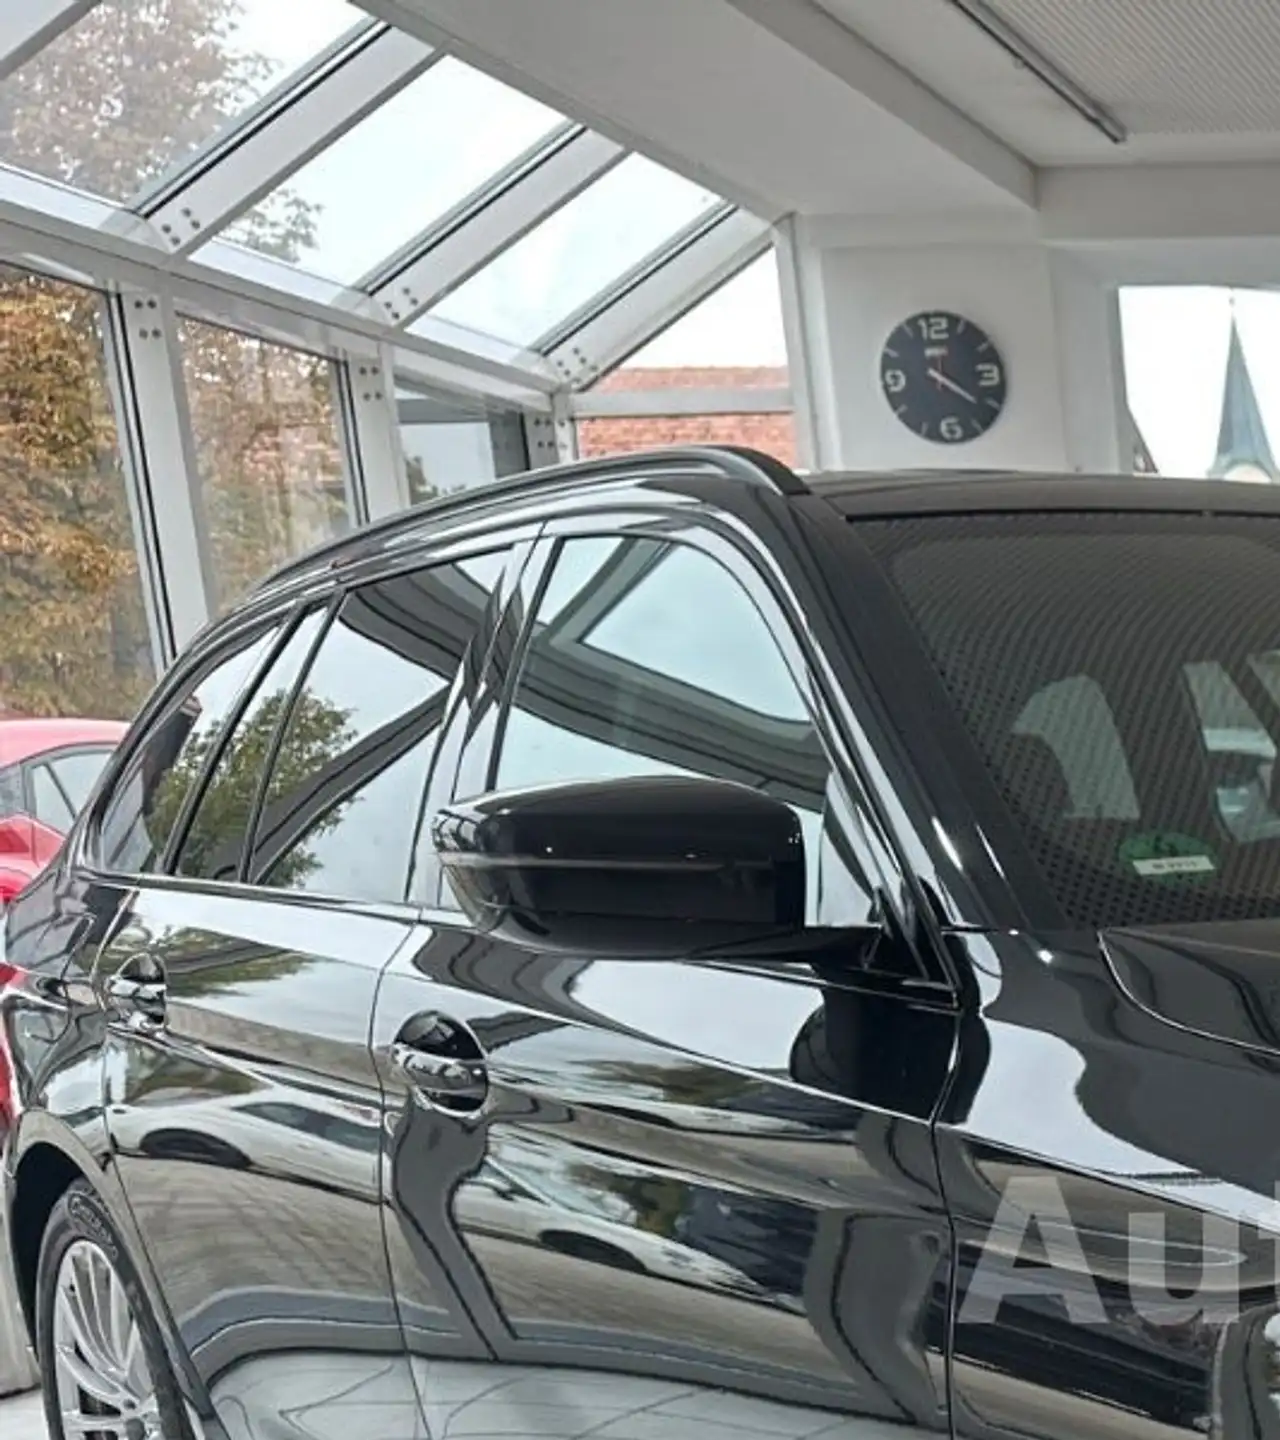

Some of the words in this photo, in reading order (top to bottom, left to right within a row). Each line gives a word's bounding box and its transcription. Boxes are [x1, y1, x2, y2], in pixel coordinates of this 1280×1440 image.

[918, 317, 949, 340] 12
[885, 369, 906, 392] 9
[975, 363, 1000, 387] 3
[940, 416, 963, 440] 6
